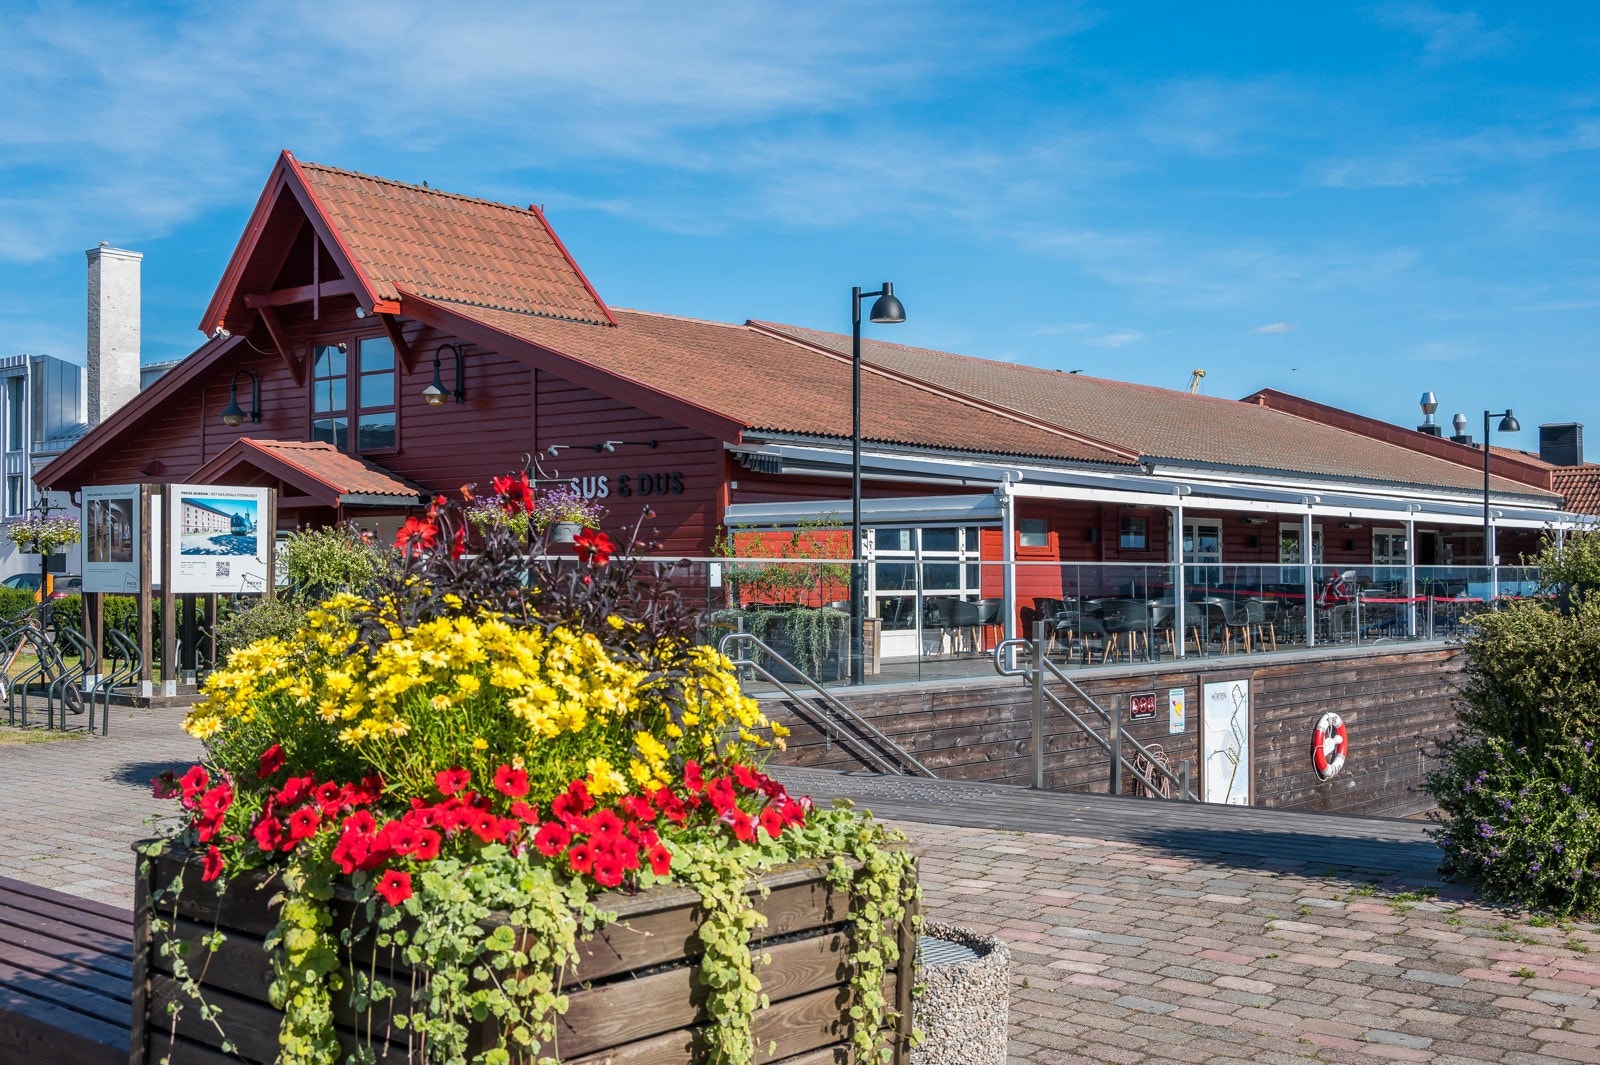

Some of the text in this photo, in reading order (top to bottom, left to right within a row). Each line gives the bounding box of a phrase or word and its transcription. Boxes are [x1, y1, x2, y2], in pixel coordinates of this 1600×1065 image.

[570, 471, 684, 499] SUS & DUS
